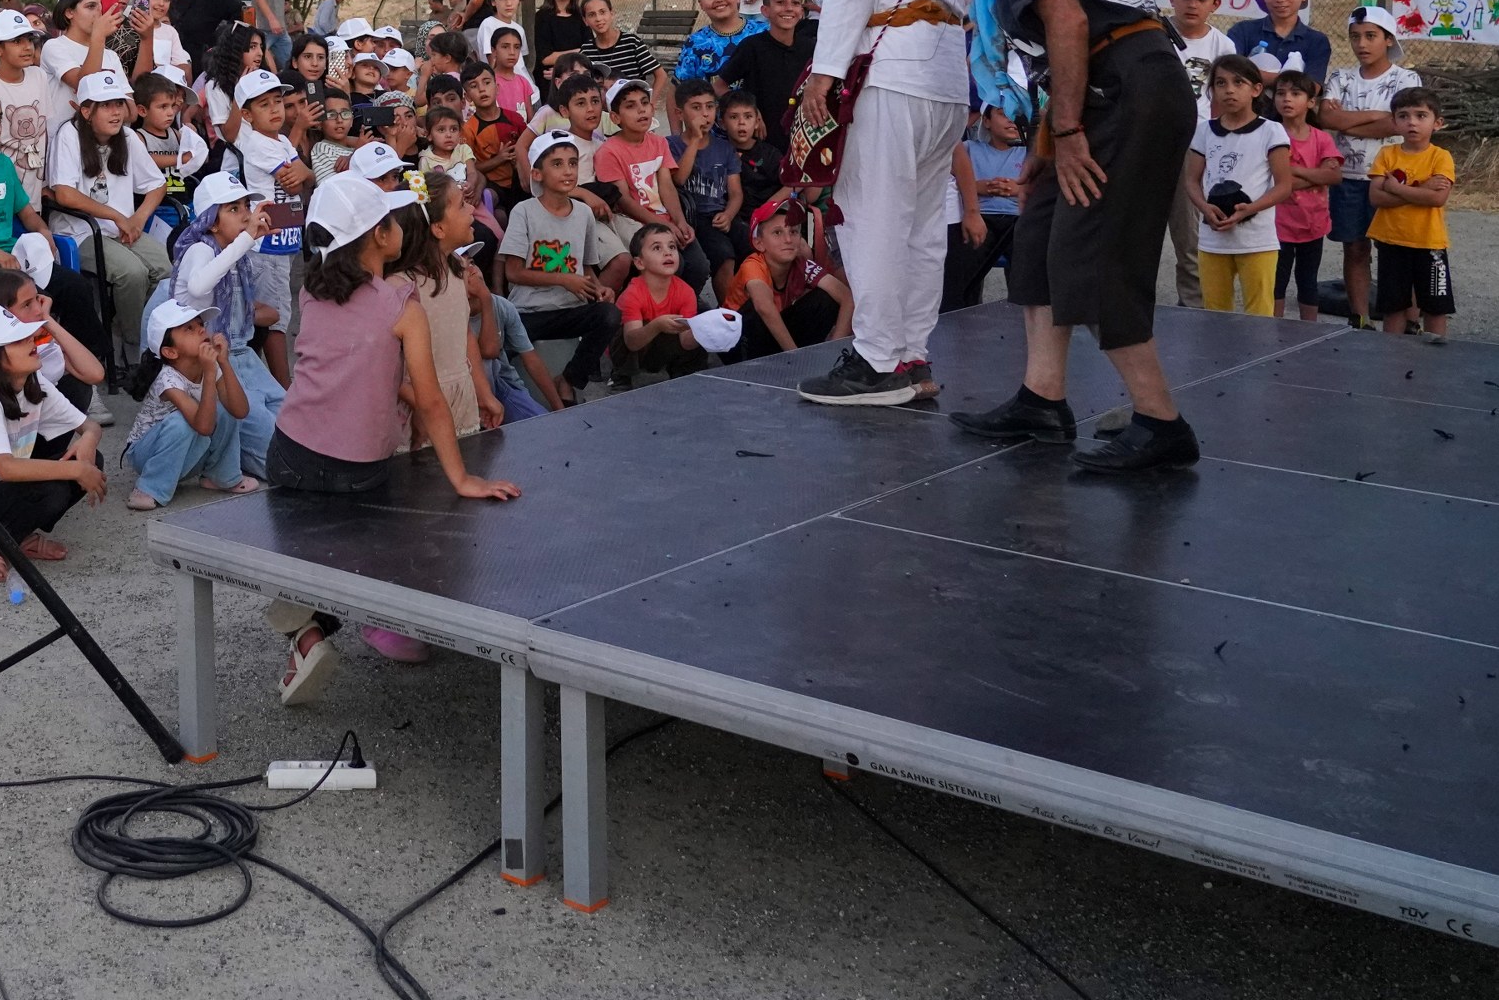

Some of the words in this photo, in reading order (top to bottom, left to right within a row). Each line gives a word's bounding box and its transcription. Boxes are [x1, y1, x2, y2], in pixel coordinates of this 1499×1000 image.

[1438, 264, 1447, 296] SONIC
[186, 565, 203, 577] GALA
[870, 762, 898, 776] GALA
[900, 769, 936, 787] SAHNE
[938, 780, 1002, 805] SİSTEMLERİ
[1399, 906, 1429, 919] TÜV
